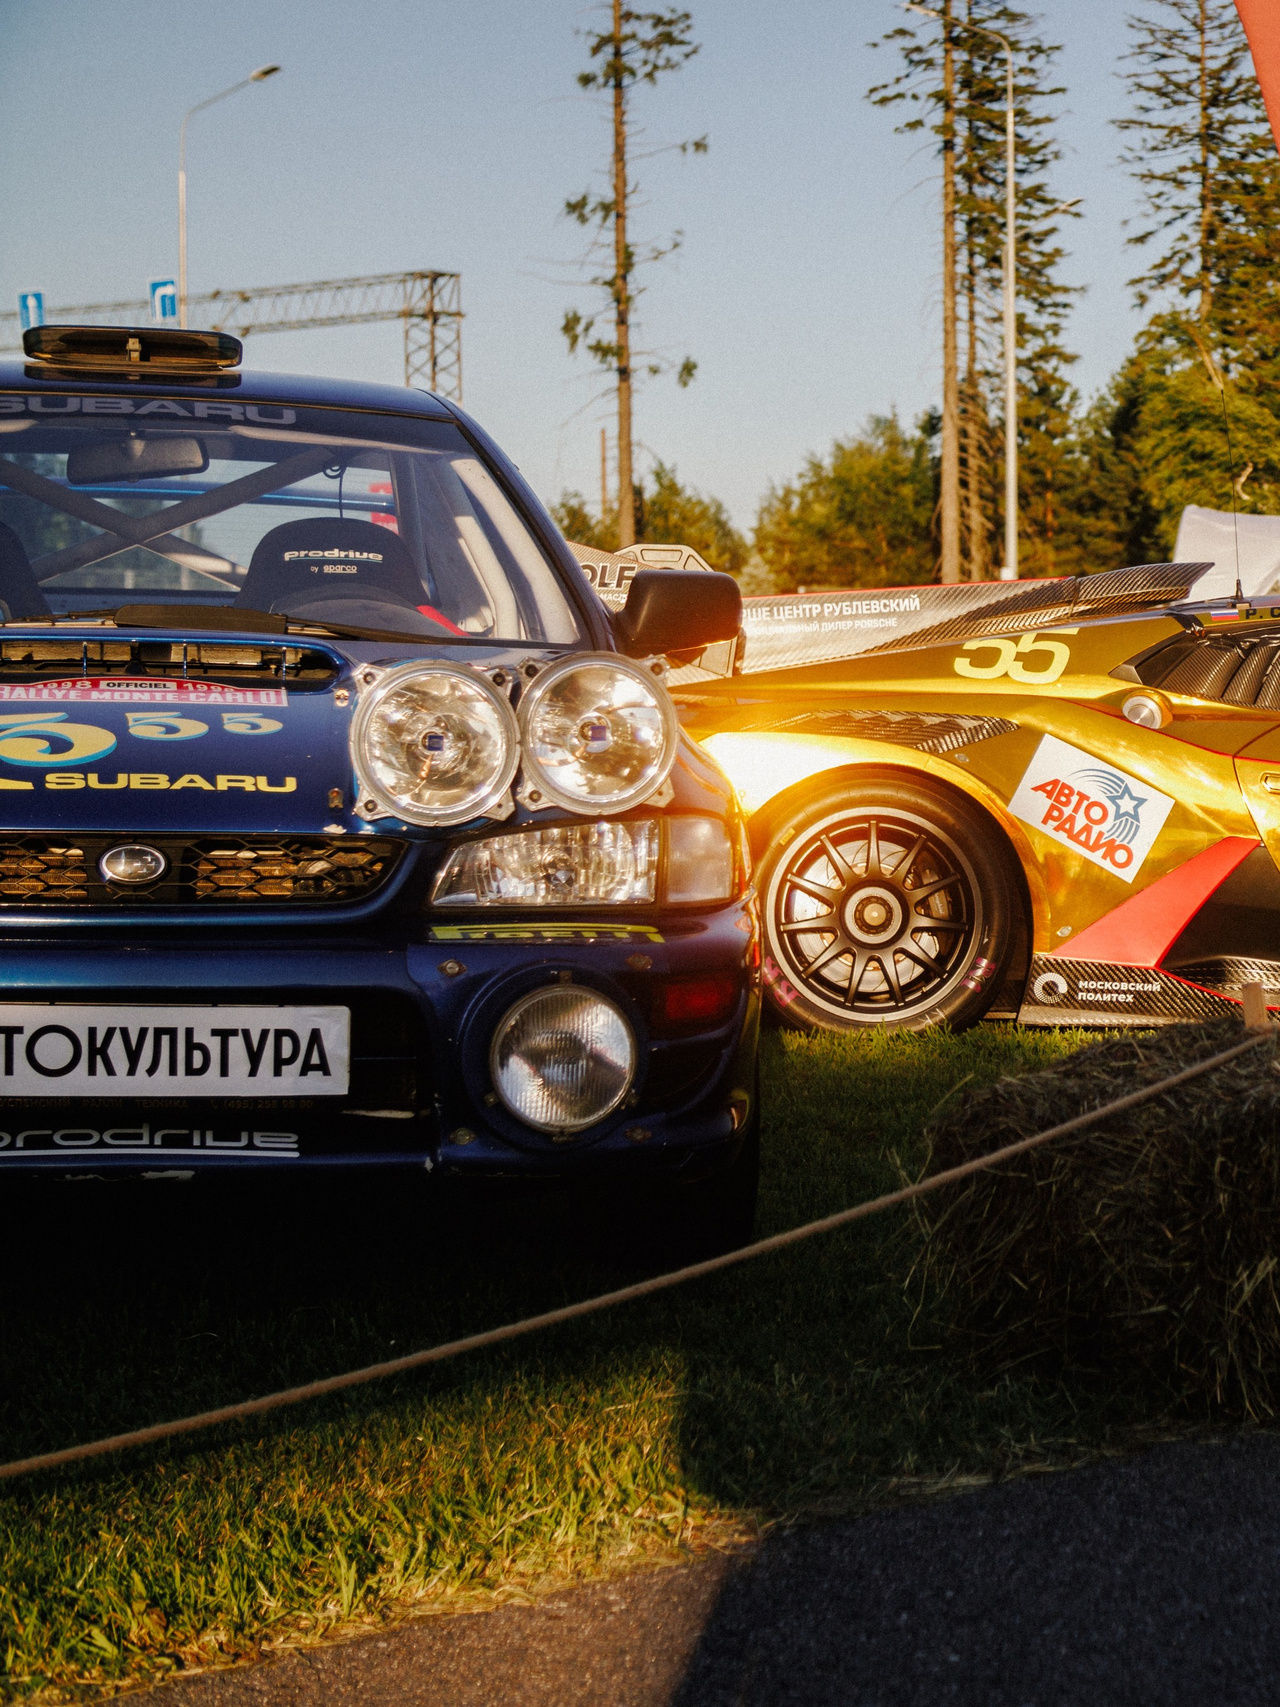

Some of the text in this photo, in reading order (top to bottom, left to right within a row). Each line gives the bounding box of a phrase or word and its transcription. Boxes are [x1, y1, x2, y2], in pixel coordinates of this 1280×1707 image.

[284, 548, 384, 561] prodrive
[323, 564, 358, 573] sparco
[580, 563, 637, 590] OLF
[773, 602, 822, 622] ЦЕНТР
[824, 595, 921, 617] РУБЛЕВСКИЙ
[1245, 608, 1263, 619] Р.
[821, 620, 854, 633] ДИЛЕР
[854, 617, 898, 630] PORSCHE
[91, 690, 277, 704] MONTE-CARLO
[45, 772, 298, 793] SUBARU
[1030, 778, 1109, 826] АВТО
[1040, 802, 1134, 869] РАДИО
[0, 1023, 332, 1078] ТОКУЛЬТУРА
[0, 1123, 299, 1150] rodrive
